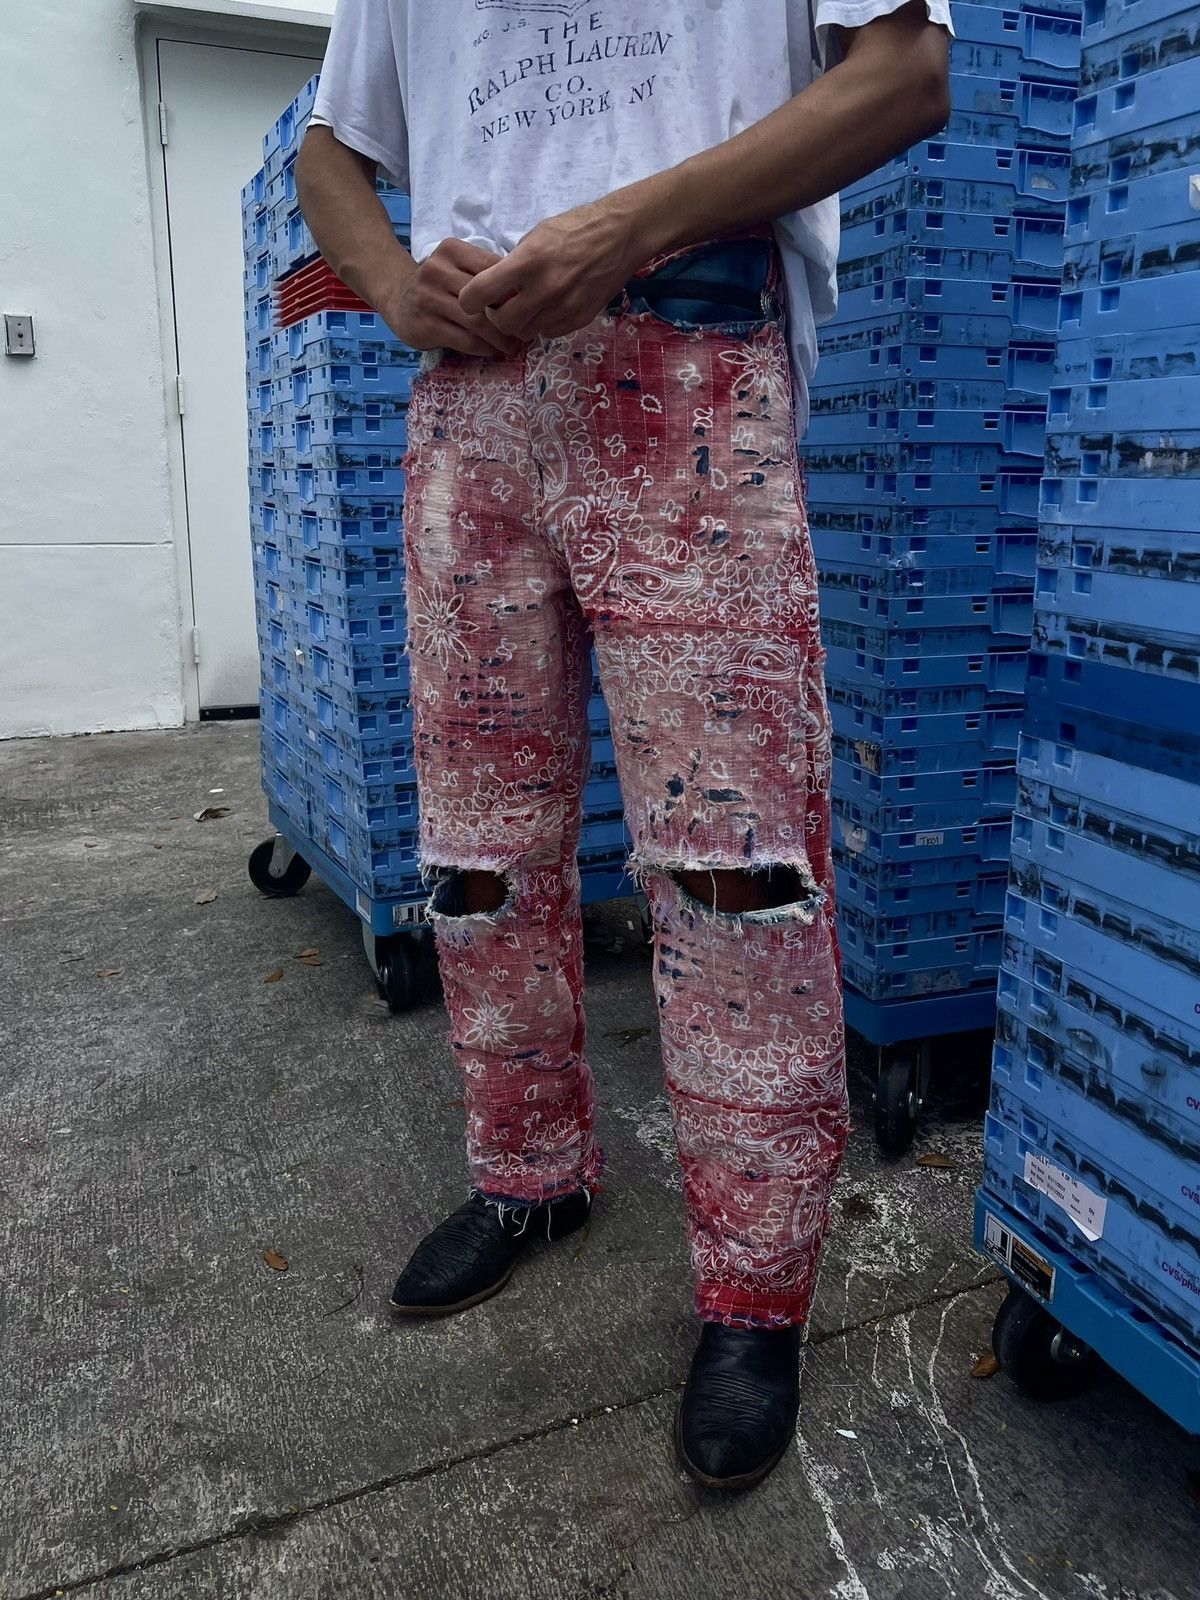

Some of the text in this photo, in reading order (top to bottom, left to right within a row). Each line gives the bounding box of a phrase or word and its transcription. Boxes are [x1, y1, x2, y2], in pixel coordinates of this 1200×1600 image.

[538, 11, 602, 44] THE
[467, 31, 674, 116] RALPH LAUREN
[545, 75, 592, 102] CO.
[481, 110, 537, 143] NEW
[629, 75, 656, 104] NY
